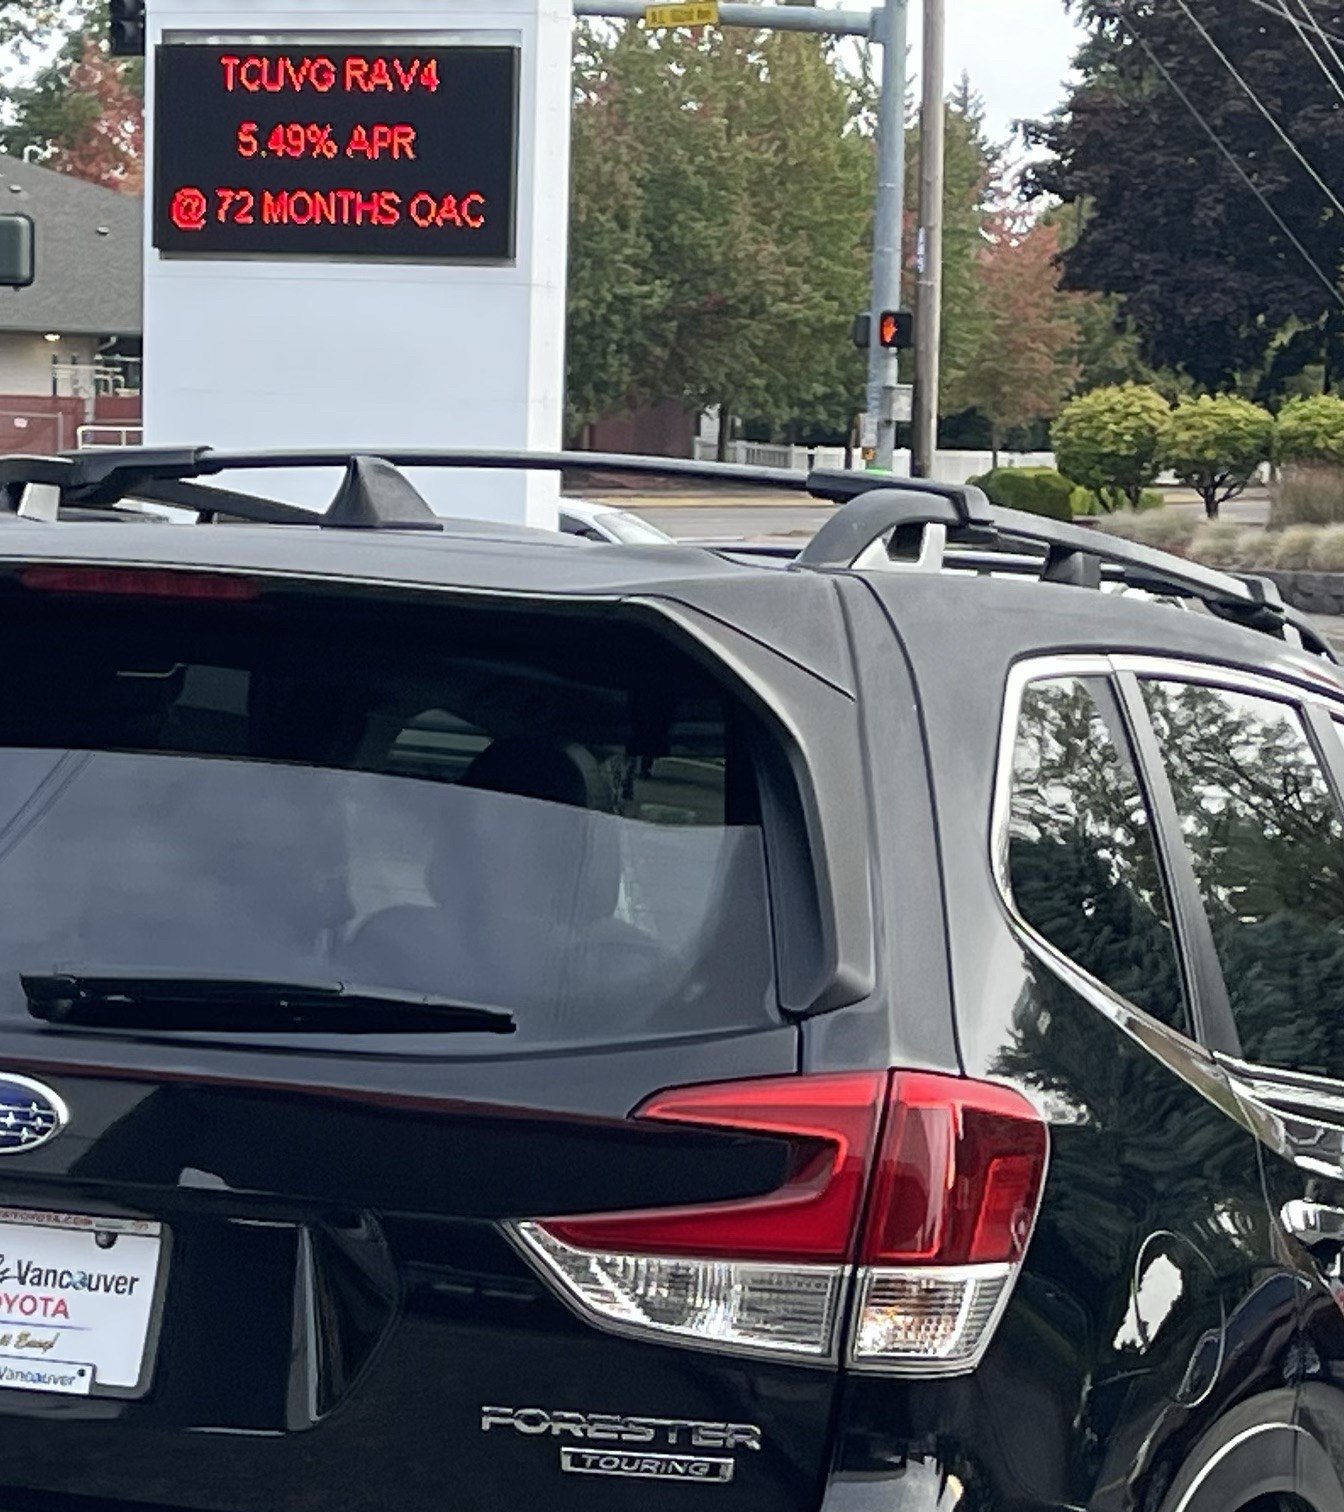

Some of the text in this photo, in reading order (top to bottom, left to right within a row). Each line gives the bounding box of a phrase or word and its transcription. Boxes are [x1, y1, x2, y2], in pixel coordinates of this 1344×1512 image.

[220, 57, 440, 93] TCUVG RAV4
[236, 121, 417, 160] 5.49% APR
[169, 186, 485, 230] @ 72 MONTHS OAC
[16, 1259, 140, 1296] Vancouver
[481, 1405, 762, 1450] FORESTER
[581, 1454, 710, 1477] TOURING
